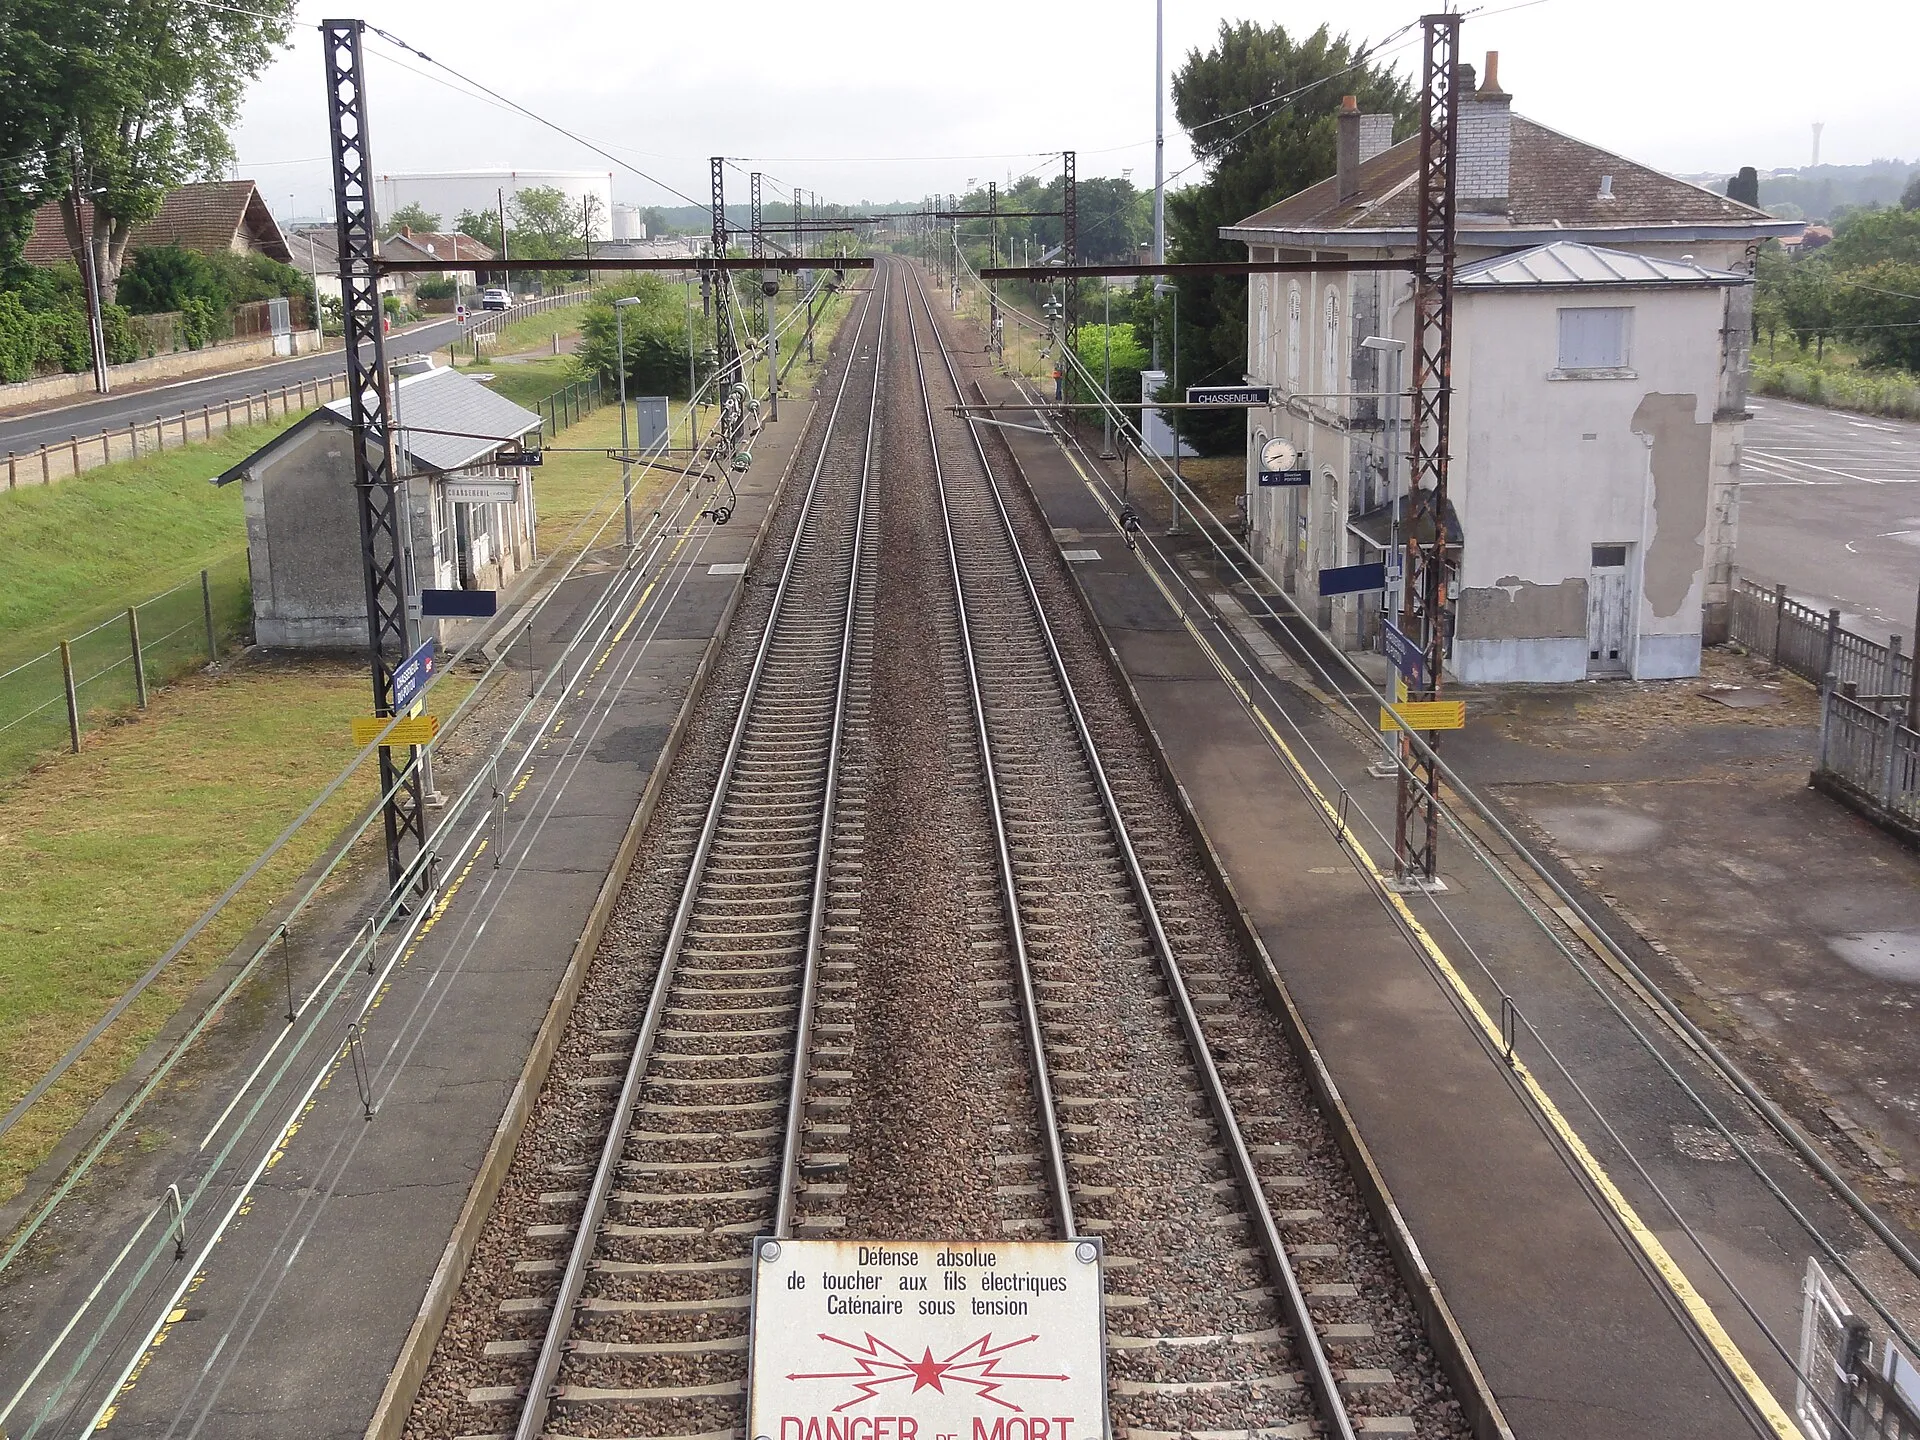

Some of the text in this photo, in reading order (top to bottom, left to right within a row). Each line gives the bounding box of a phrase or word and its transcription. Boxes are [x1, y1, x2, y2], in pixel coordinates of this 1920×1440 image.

[1198, 394, 1260, 404] CHASSENEUIL
[858, 1246, 996, 1268] Défense absolue
[787, 1270, 1067, 1296] de toucher aux fils électriques
[827, 1294, 1028, 1316] Caténaire sous tension
[780, 1416, 1075, 1440] DANGER MORT
